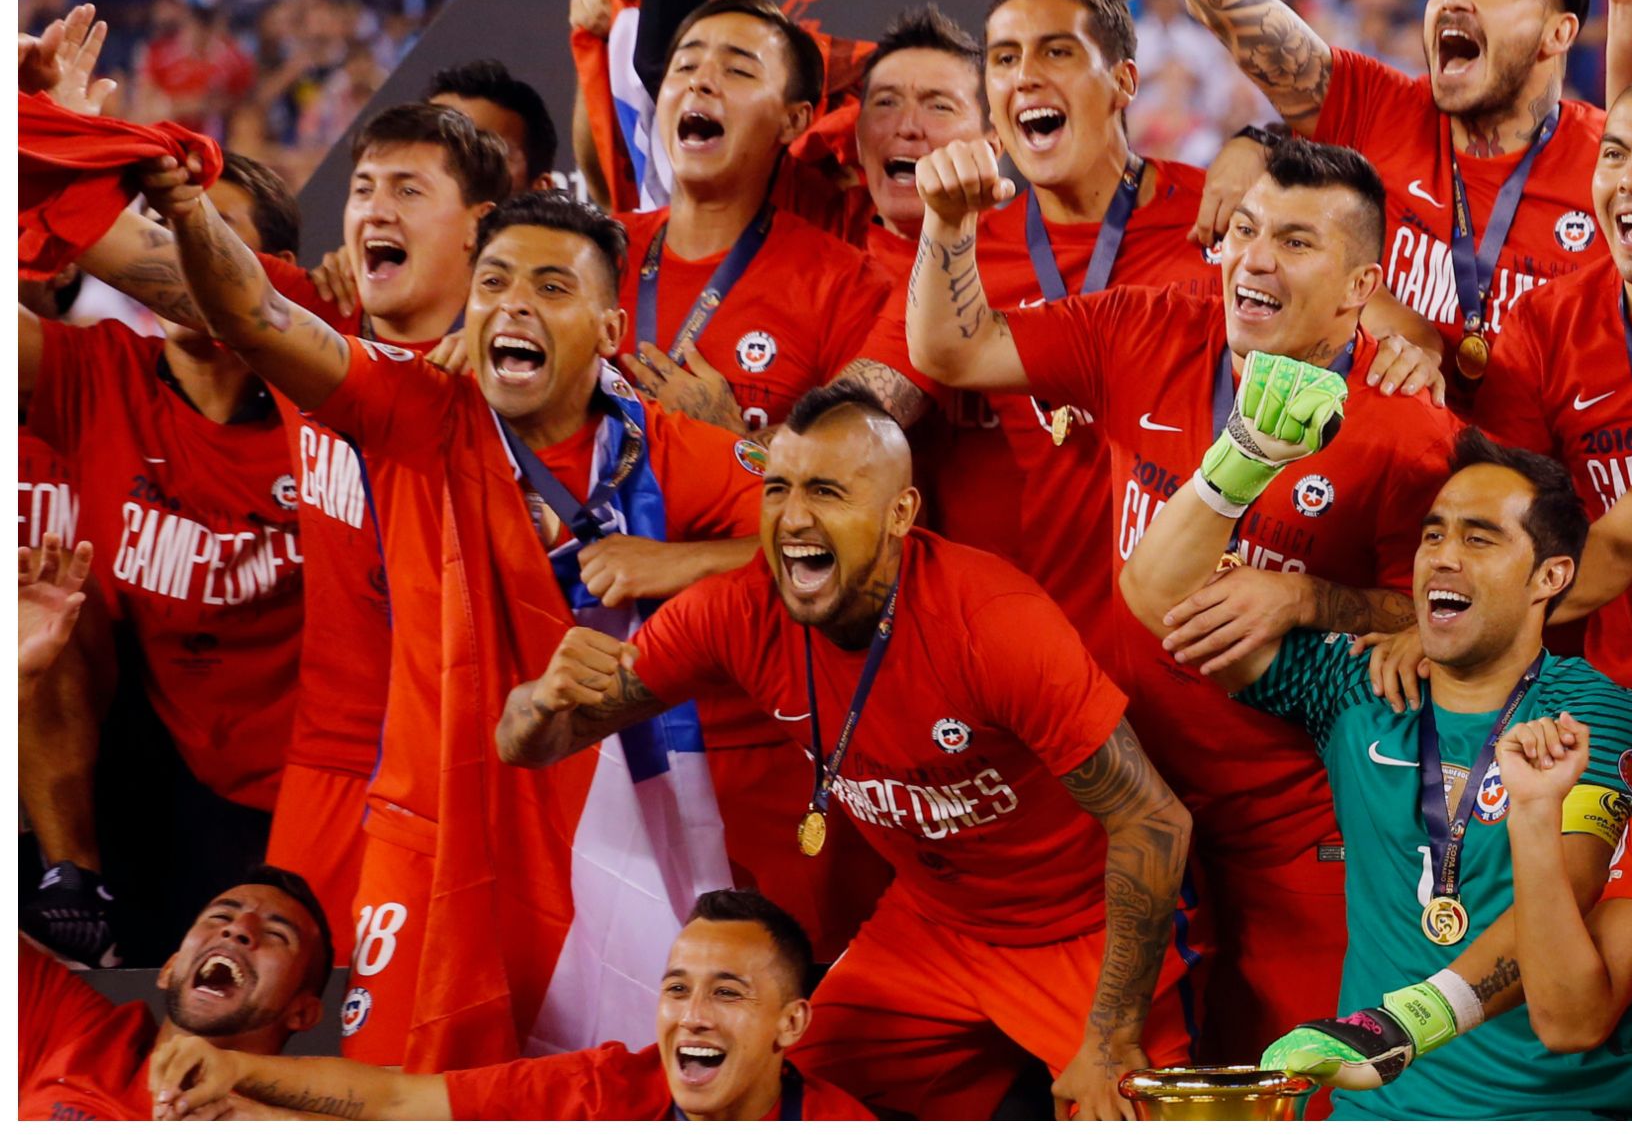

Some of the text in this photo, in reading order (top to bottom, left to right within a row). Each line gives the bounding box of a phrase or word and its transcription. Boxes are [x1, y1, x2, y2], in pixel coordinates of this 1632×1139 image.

[1131, 454, 1181, 498] 2016
[1583, 814, 1609, 825] COPA
[1450, 842, 1459, 867] COPA
[353, 901, 408, 977] 18
